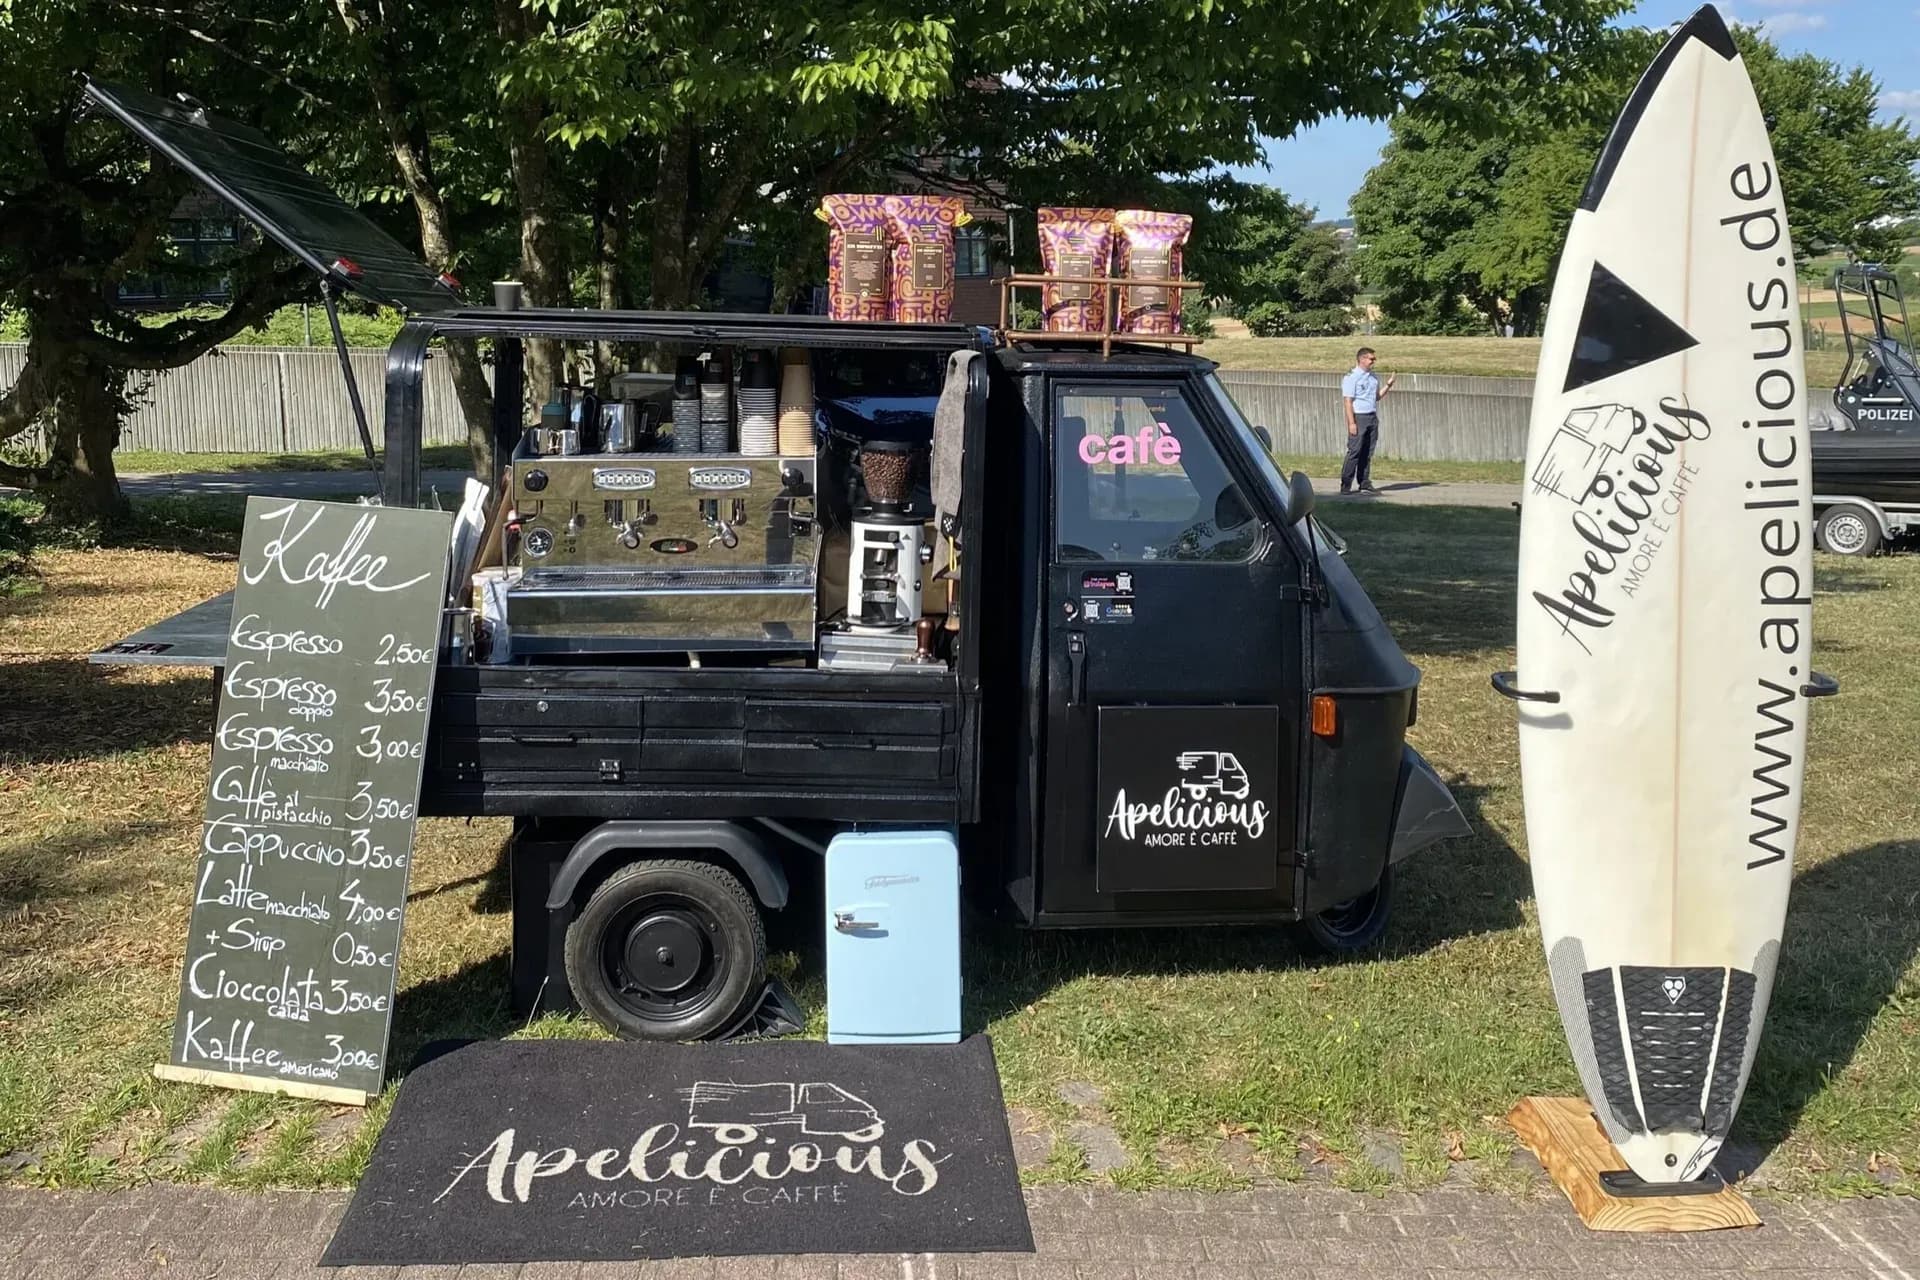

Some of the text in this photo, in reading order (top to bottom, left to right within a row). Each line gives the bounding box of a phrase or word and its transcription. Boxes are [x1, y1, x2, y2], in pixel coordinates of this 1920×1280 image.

[1858, 409, 1913, 420] POLIZEI
[1532, 392, 1711, 656] Apelicious
[1720, 161, 1812, 870] www.apelicious.de
[243, 501, 432, 610] Kaffee
[1620, 534, 1662, 599] AMORE
[231, 614, 344, 663] Espresso
[225, 661, 428, 717] Espresso 3,50€
[288, 705, 334, 723] doppio
[216, 713, 423, 764] Espresso 3,00€
[270, 753, 330, 773] macchiato
[261, 806, 332, 827] pistacchio
[286, 790, 299, 807] al
[345, 781, 414, 823] 3,50€
[1105, 787, 1270, 840] Apelicious
[347, 828, 406, 869] 3,50€
[1145, 833, 1186, 847] AMORE
[196, 860, 400, 925] Latte macchiato 4,00€
[206, 930, 220, 945] +
[221, 918, 286, 960] Sirup
[189, 952, 389, 1016] Cioccolata 3,50€
[267, 1004, 310, 1022] calda
[182, 1010, 280, 1072] Kaffee
[321, 1034, 380, 1072] 3,00€
[432, 1123, 955, 1203] Apelicious
[568, 1187, 694, 1208] AMORE
